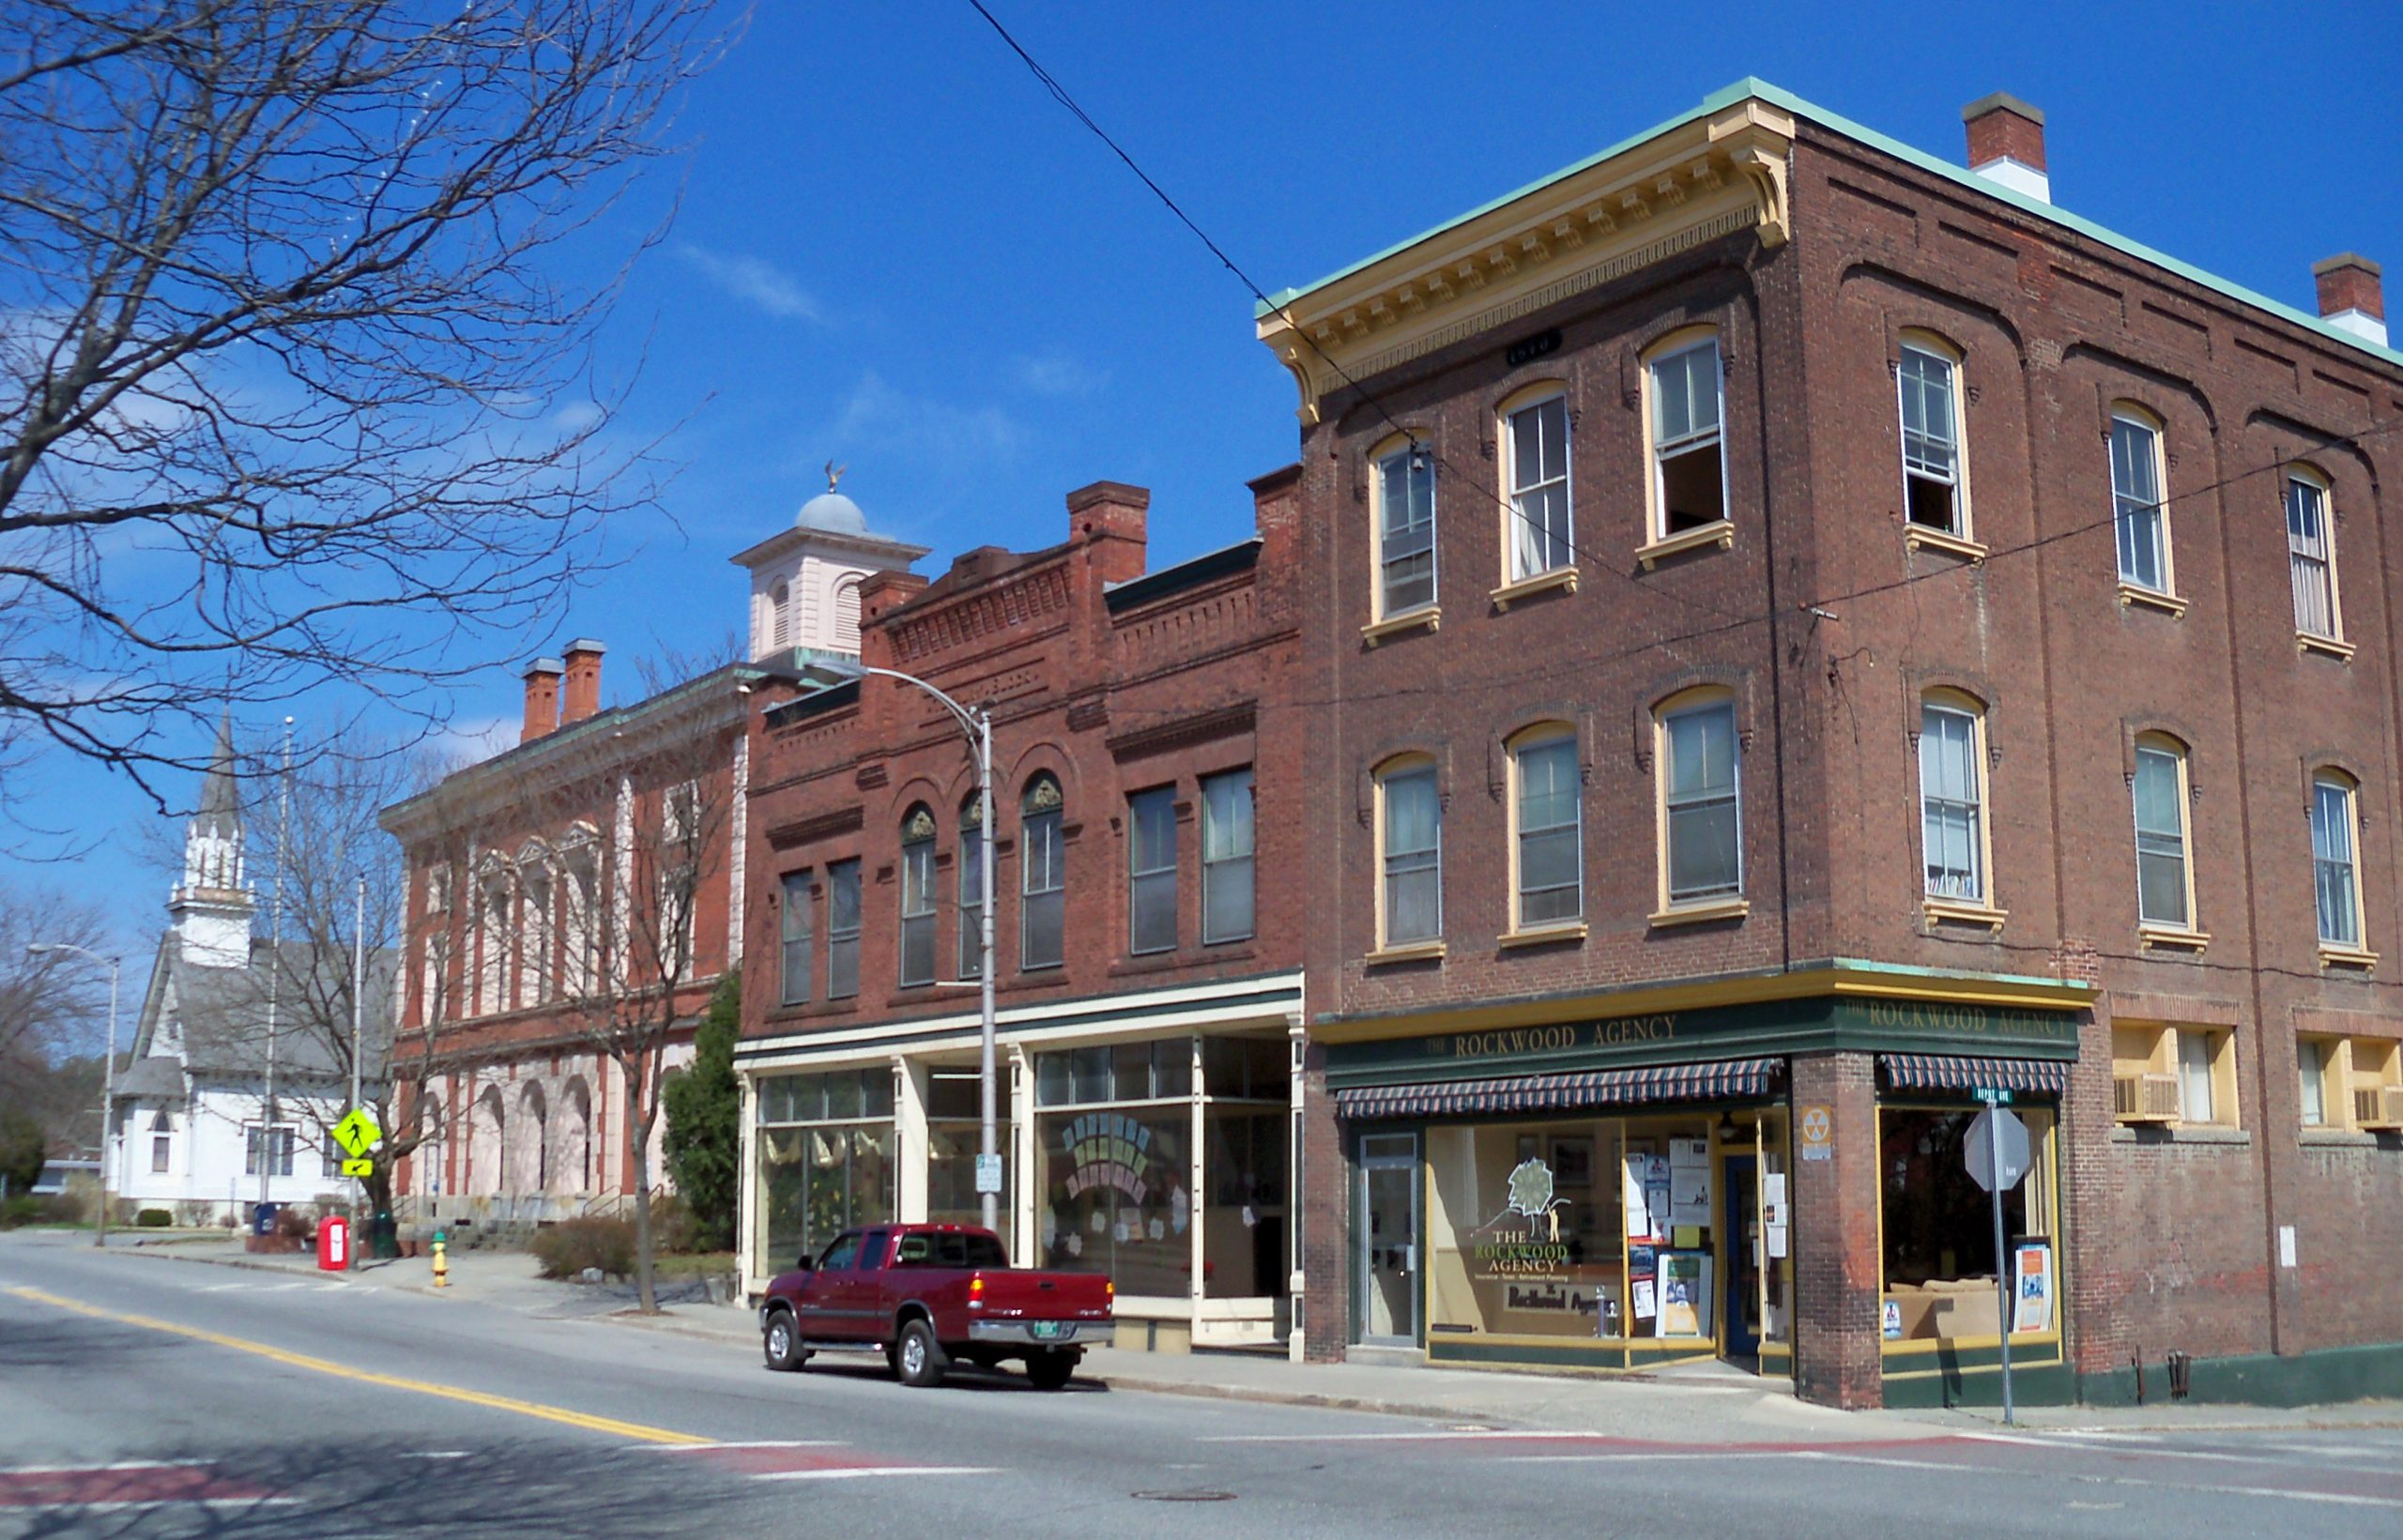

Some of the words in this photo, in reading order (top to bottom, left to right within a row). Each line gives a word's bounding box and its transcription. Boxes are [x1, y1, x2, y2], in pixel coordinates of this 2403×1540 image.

[1845, 998, 1866, 1017] THE
[1870, 1000, 1988, 1032] ROCKWOOD
[1997, 1009, 2067, 1036] AGENCY
[1426, 1037, 1446, 1055] THE
[1455, 1025, 1576, 1059] ROCKWOOD
[1593, 1014, 1677, 1046] AGENCY
[1492, 1230, 1527, 1243] THE
[1475, 1244, 1569, 1259] ROCKWOOD
[1489, 1258, 1558, 1273] AGENCY
